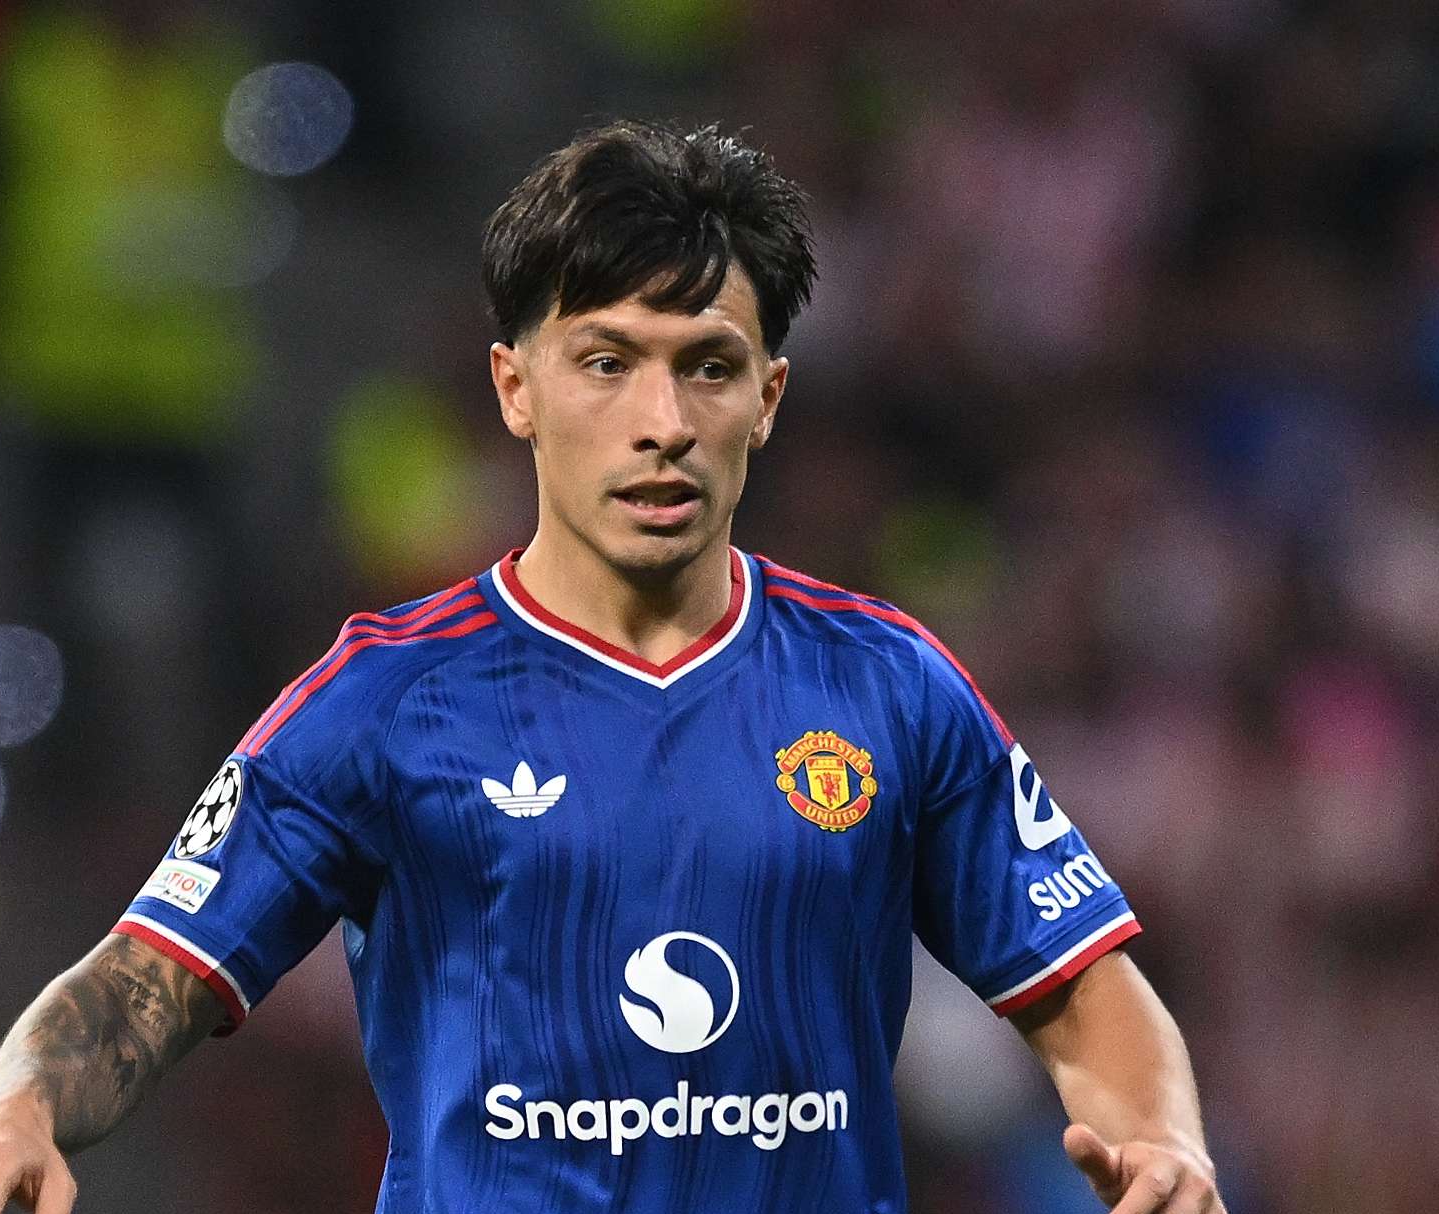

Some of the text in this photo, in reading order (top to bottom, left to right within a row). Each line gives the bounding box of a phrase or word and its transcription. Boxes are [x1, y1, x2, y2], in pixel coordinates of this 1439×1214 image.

[784, 738, 868, 769] MANCHESTER
[805, 804, 859, 824] UNITED
[1028, 850, 1112, 921] sum
[485, 1080, 849, 1156] Snapdragon
